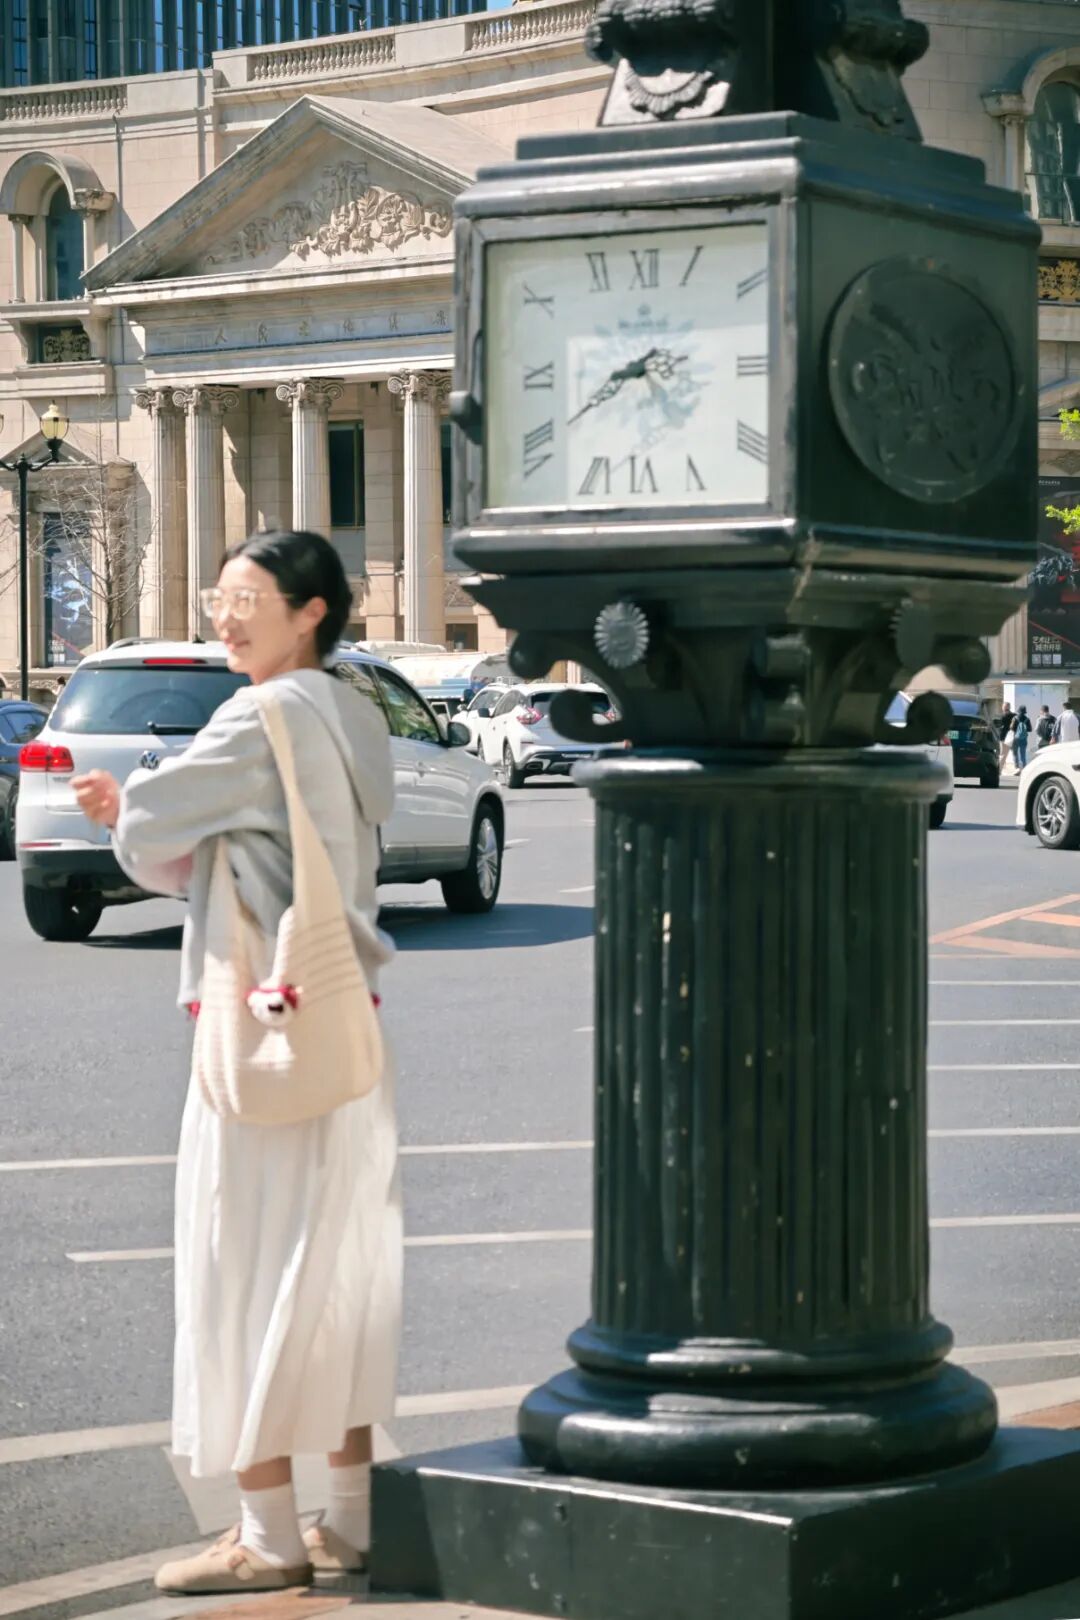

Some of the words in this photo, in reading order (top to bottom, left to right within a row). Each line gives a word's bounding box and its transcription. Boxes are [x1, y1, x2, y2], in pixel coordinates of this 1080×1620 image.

[628, 248, 660, 291] XII
[523, 361, 555, 392] IX
[736, 355, 768, 378] III
[523, 418, 555, 480] VIII
[577, 456, 612, 495] VII
[629, 455, 659, 494] VI
[685, 454, 707, 491] V
